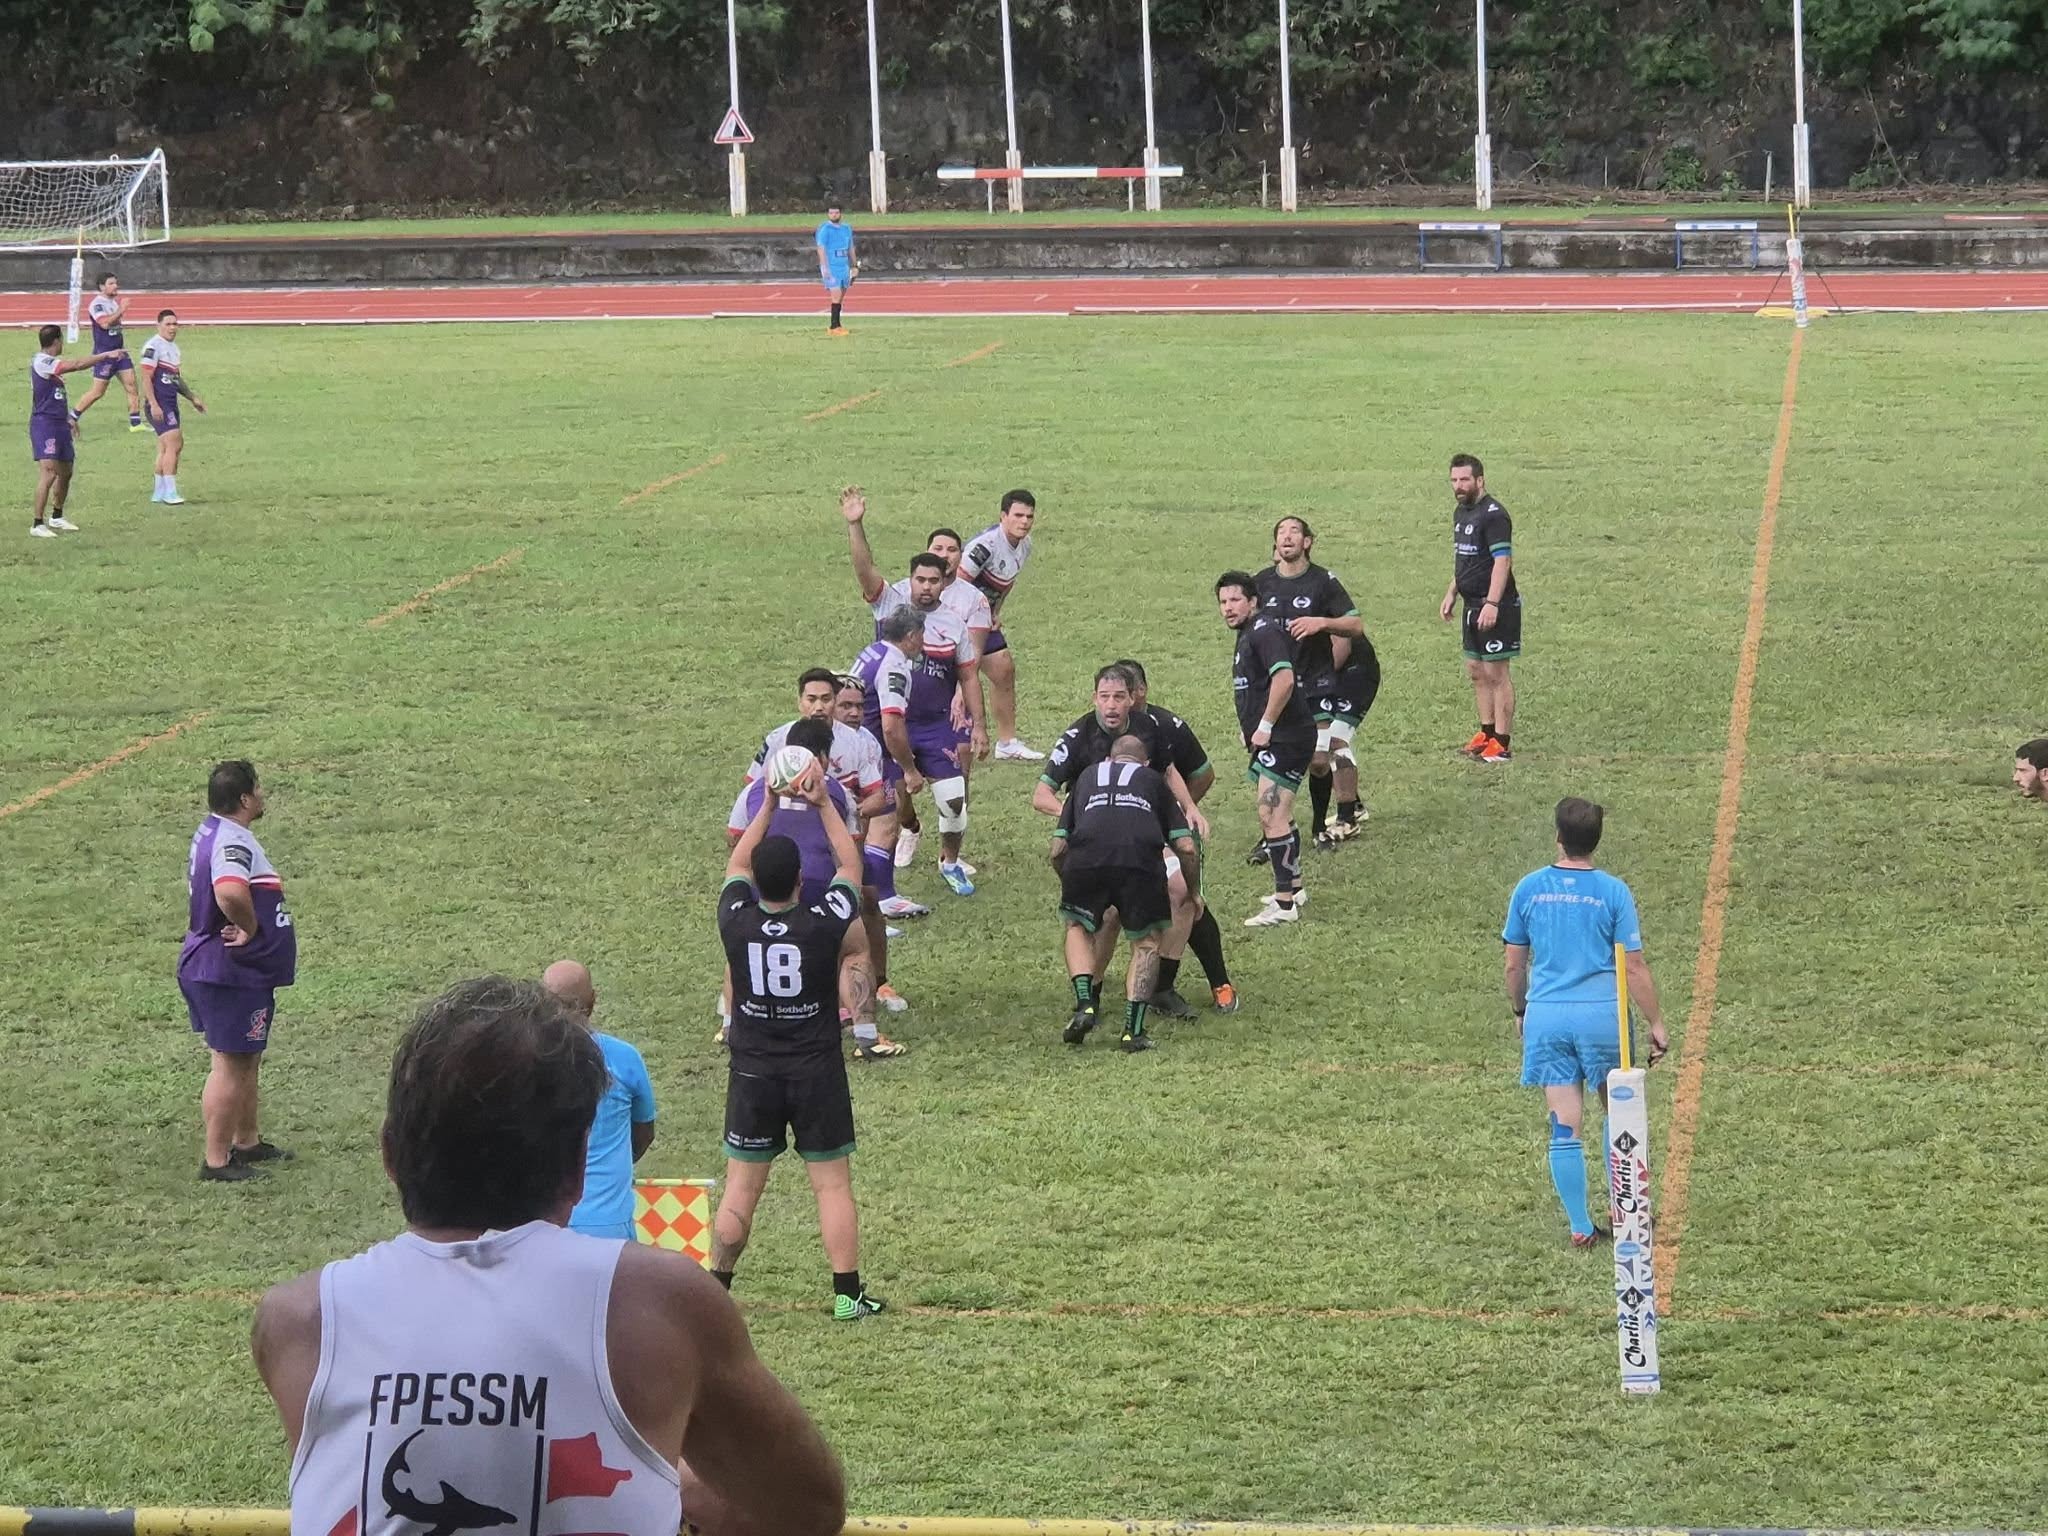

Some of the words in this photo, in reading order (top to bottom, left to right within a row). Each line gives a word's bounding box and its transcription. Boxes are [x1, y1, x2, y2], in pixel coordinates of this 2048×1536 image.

[1097, 761, 1142, 787] 17
[747, 942, 802, 998] 18
[1616, 1158, 1638, 1214] Charlie
[1624, 1313, 1647, 1368] Charlie
[368, 1372, 548, 1431] FPESSM
